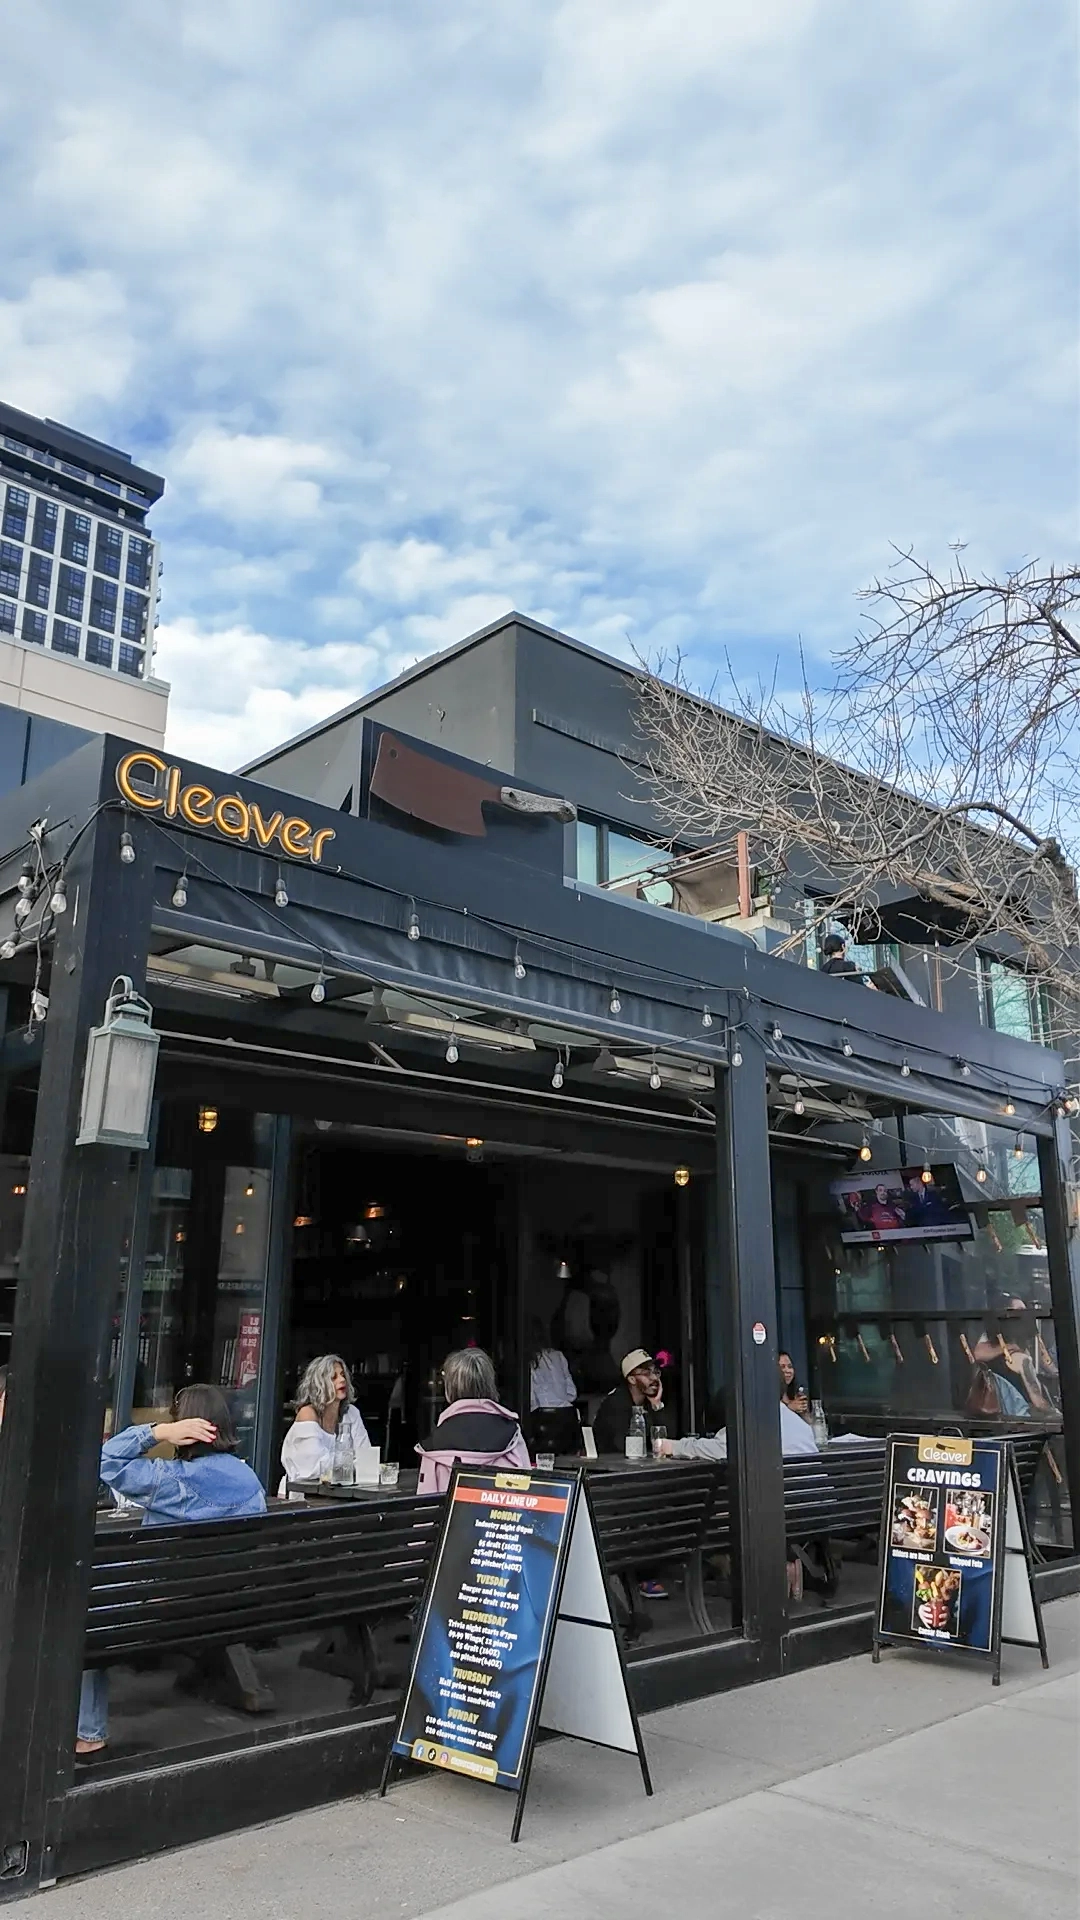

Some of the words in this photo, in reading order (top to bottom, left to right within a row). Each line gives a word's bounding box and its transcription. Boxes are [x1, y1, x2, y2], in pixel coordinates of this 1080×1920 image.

[116, 751, 336, 864] Cleaver
[923, 1447, 968, 1462] Cleaver
[907, 1468, 981, 1488] CRAVINGS
[481, 1492, 507, 1504] DAILY
[506, 1494, 525, 1506] LINE
[526, 1497, 538, 1507] UP
[490, 1510, 522, 1522] MONDAY
[475, 1519, 500, 1530] Industry
[500, 1522, 516, 1532] night
[486, 1541, 501, 1549] draft
[496, 1532, 519, 1542] cocktail
[493, 1551, 506, 1560] food
[506, 1554, 523, 1562] menu
[476, 1574, 510, 1588] TUESDAY
[458, 1592, 478, 1603] Burger
[483, 1597, 498, 1606] draft
[462, 1583, 481, 1594] Burger
[482, 1588, 492, 1596] and
[494, 1590, 506, 1598] beer
[506, 1591, 520, 1600] deal
[462, 1610, 508, 1628] WEDNESDAY
[448, 1619, 465, 1629] Trivia
[466, 1623, 482, 1633] night
[482, 1626, 499, 1636] starts
[464, 1642, 479, 1652] draft
[492, 1640, 508, 1649] piece
[453, 1667, 492, 1686] THURSDAY
[439, 1677, 451, 1686] Half
[451, 1682, 467, 1691] price
[467, 1686, 482, 1695] wine
[483, 1688, 502, 1700] bottle
[450, 1691, 466, 1701] steak
[466, 1696, 496, 1709] sandwich
[448, 1707, 480, 1724] SUNDAY
[436, 1718, 456, 1729] double
[456, 1724, 478, 1736] cleaver
[478, 1731, 498, 1742] caesar
[436, 1728, 457, 1740] cleaver
[457, 1735, 476, 1746] caesar
[476, 1740, 494, 1752] stack
